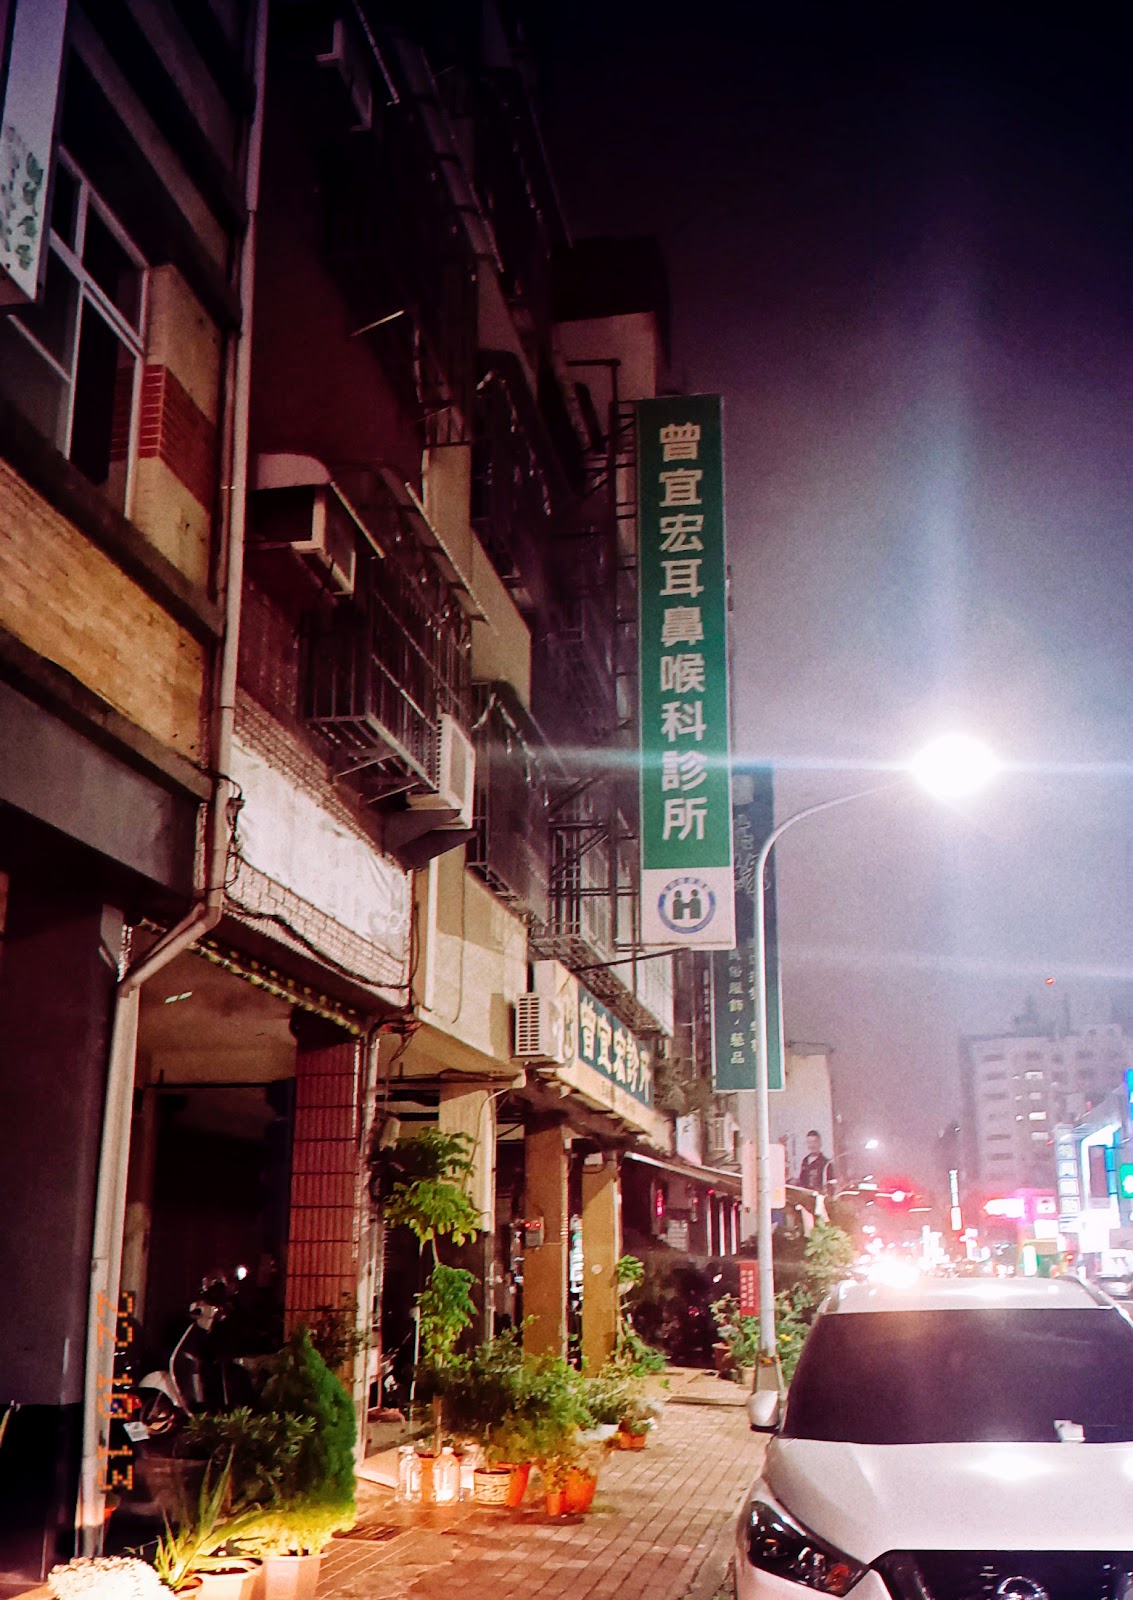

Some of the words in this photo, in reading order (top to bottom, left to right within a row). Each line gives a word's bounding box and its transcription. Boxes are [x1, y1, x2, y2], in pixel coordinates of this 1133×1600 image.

[658, 421, 708, 841] 曾宜宏耳鼻喉科診所
